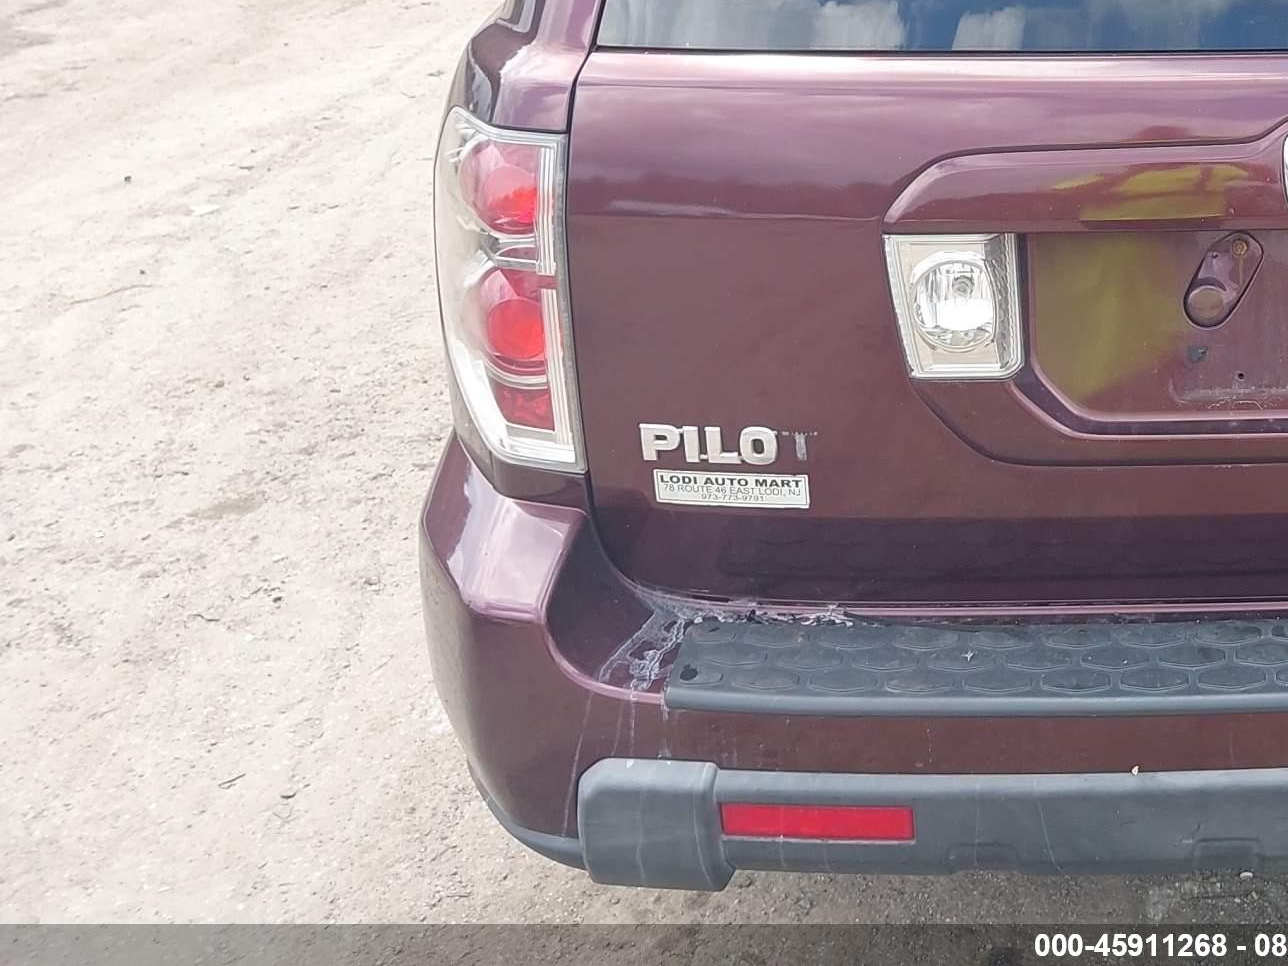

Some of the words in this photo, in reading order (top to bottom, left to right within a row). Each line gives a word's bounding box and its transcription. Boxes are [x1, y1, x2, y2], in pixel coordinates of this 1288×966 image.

[659, 474, 698, 484] LODI
[703, 477, 749, 487] AUTO
[754, 478, 802, 489] MART
[663, 484, 675, 492] 78
[677, 485, 712, 494] ROUTE
[714, 486, 727, 494] 46
[729, 487, 756, 495] EAST
[758, 488, 786, 497] LODI,
[788, 488, 801, 497] NJ
